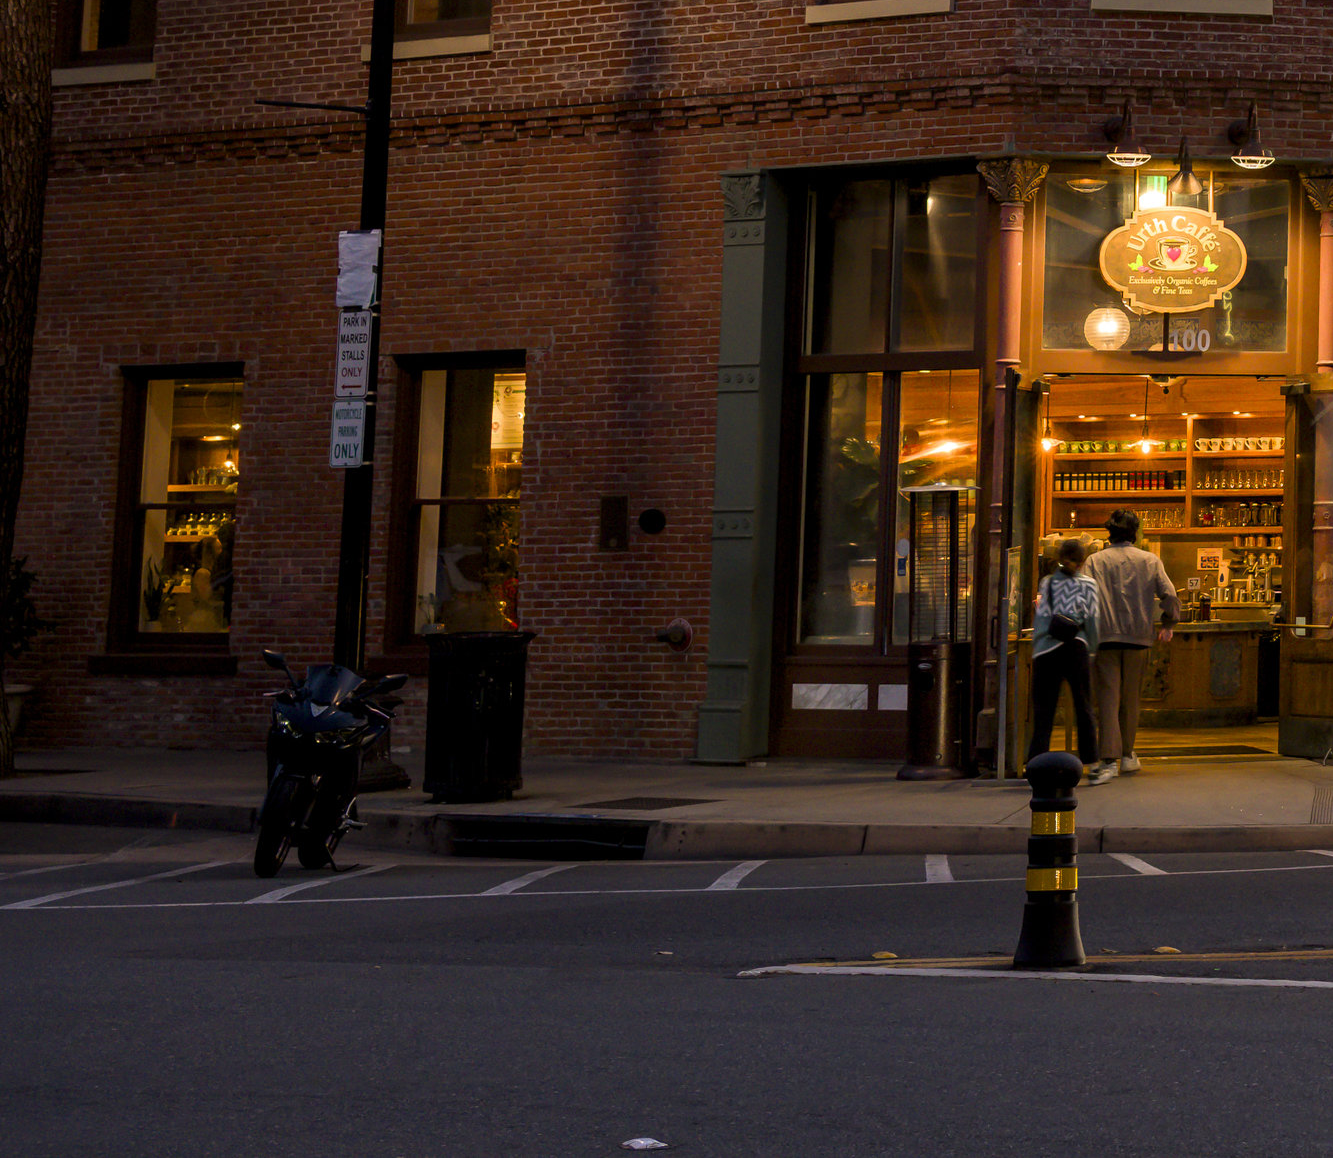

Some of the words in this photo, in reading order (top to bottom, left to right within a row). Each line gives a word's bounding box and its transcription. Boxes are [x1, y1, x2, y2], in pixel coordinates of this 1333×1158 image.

[1126, 217, 1168, 251] Urth
[1129, 276, 1166, 286] Exclusively
[1166, 276, 1194, 286] Organic
[1194, 276, 1218, 286] Coffees
[344, 317, 359, 328] PARK
[360, 316, 368, 327] IN
[340, 334, 368, 344] MARKED
[1170, 329, 1211, 352] 100
[341, 350, 365, 361] STALLS
[341, 367, 362, 378] ONLY
[338, 426, 358, 437] PARKING
[334, 443, 359, 459] ONLY
[1189, 578, 1199, 586] 57
